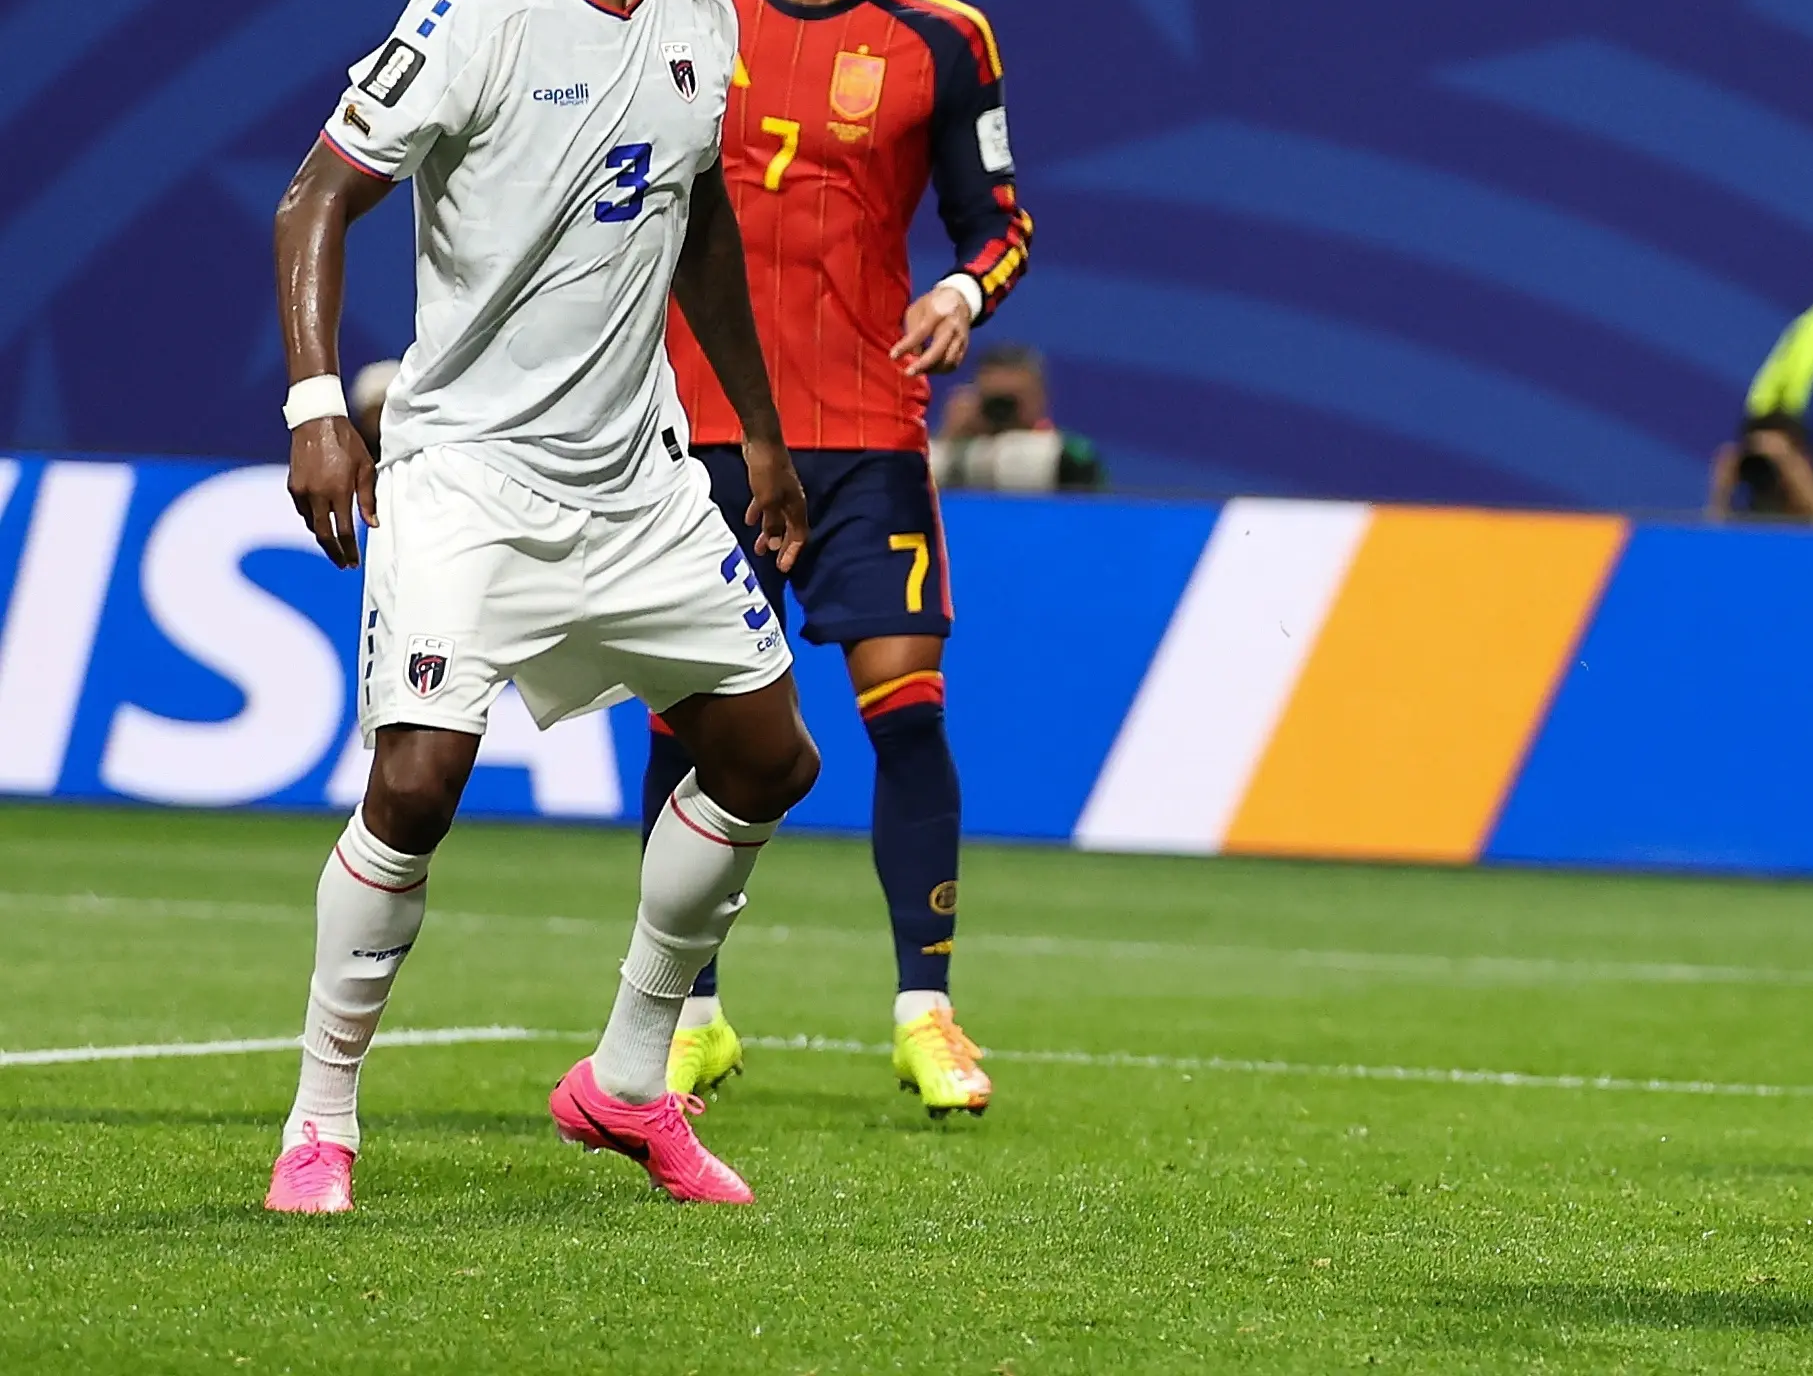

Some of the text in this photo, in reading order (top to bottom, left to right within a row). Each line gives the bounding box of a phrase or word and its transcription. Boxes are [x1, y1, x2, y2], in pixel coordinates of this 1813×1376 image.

[664, 44, 689, 54] FCF
[533, 83, 590, 105] capelli
[593, 142, 653, 223] 3
[761, 115, 801, 192] 7
[720, 543, 772, 631] 3
[887, 532, 930, 614] 7
[0, 458, 623, 815] IS
[412, 637, 449, 650] FCF
